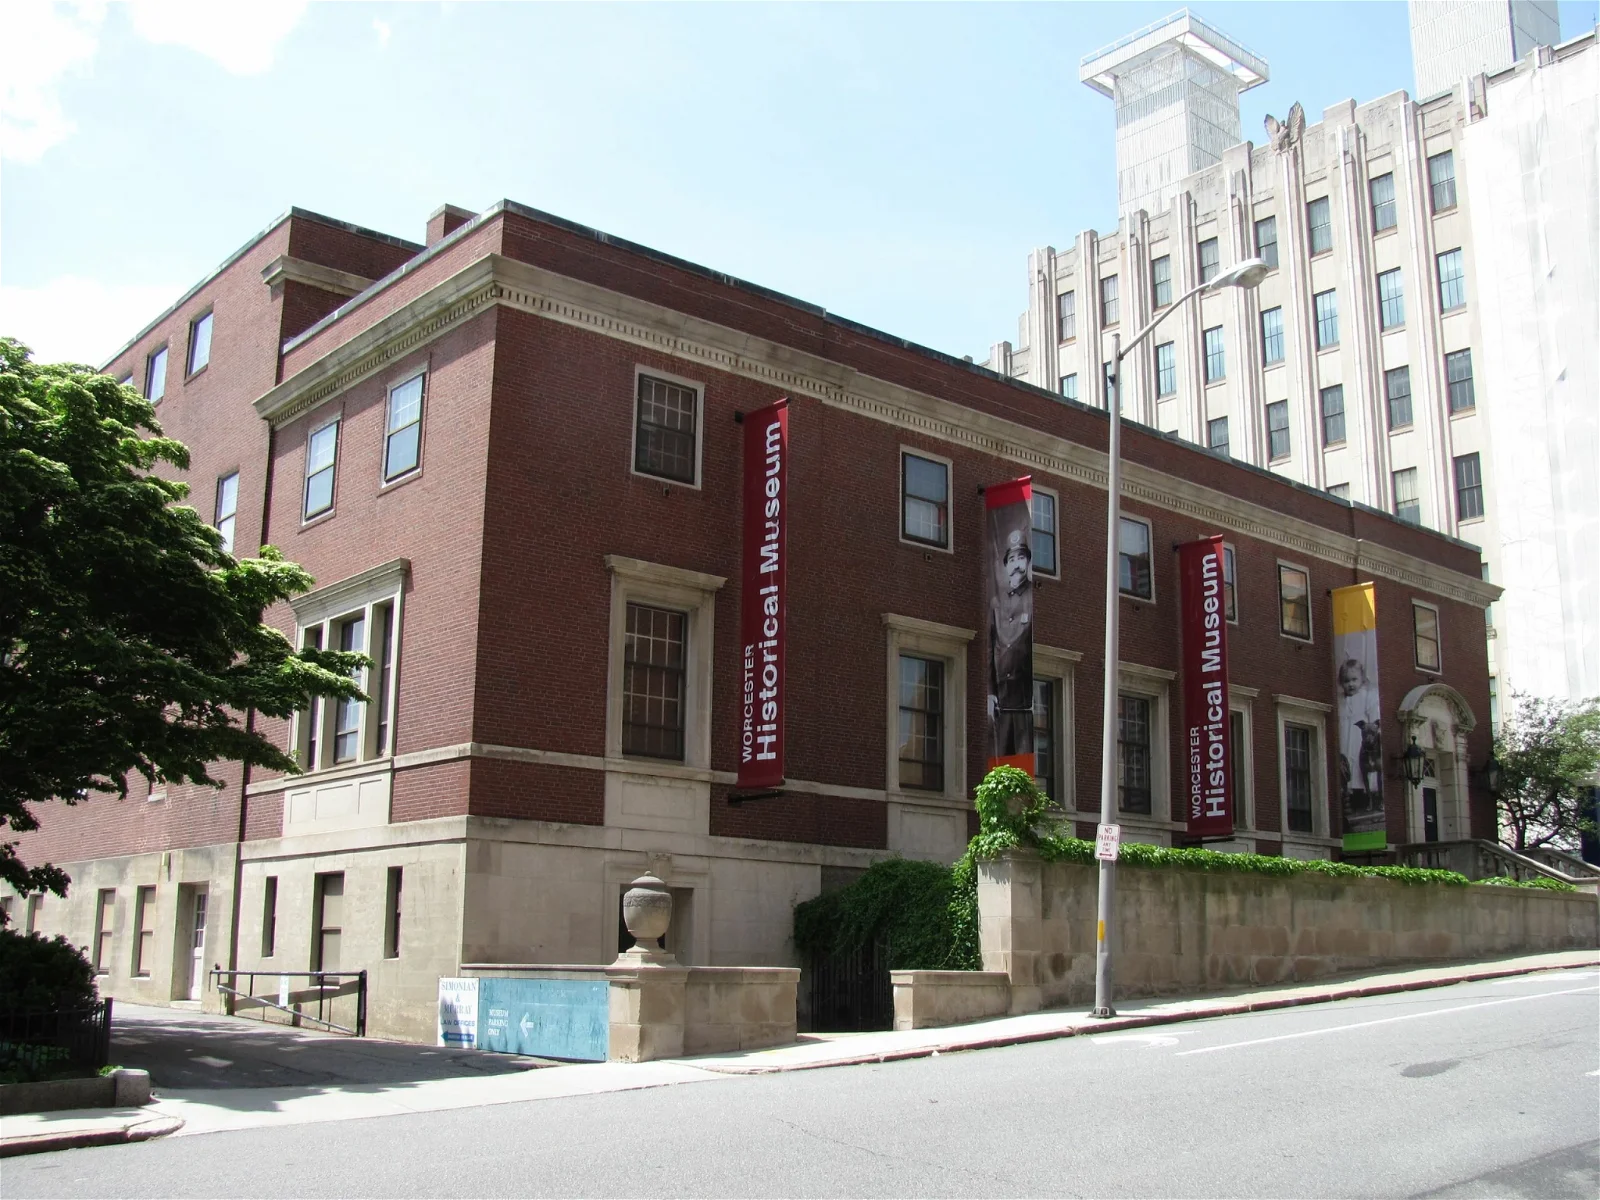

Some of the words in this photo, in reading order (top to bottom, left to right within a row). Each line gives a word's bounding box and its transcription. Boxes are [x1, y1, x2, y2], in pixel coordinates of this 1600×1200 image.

[759, 420, 781, 575] Museum
[1201, 552, 1221, 674] Museum
[756, 588, 780, 761] Historical
[742, 644, 754, 764] WORCESTER
[1202, 681, 1225, 818] Historical
[1190, 726, 1201, 820] WORCESTER
[1099, 834, 1118, 842] PARKING
[441, 981, 476, 991] SIMONIAN
[455, 993, 460, 1002] &
[444, 1004, 472, 1014] MURRAY
[489, 1009, 508, 1017] MUSEUM
[488, 1018, 508, 1026] PARKING
[488, 1028, 501, 1036] ONLY
